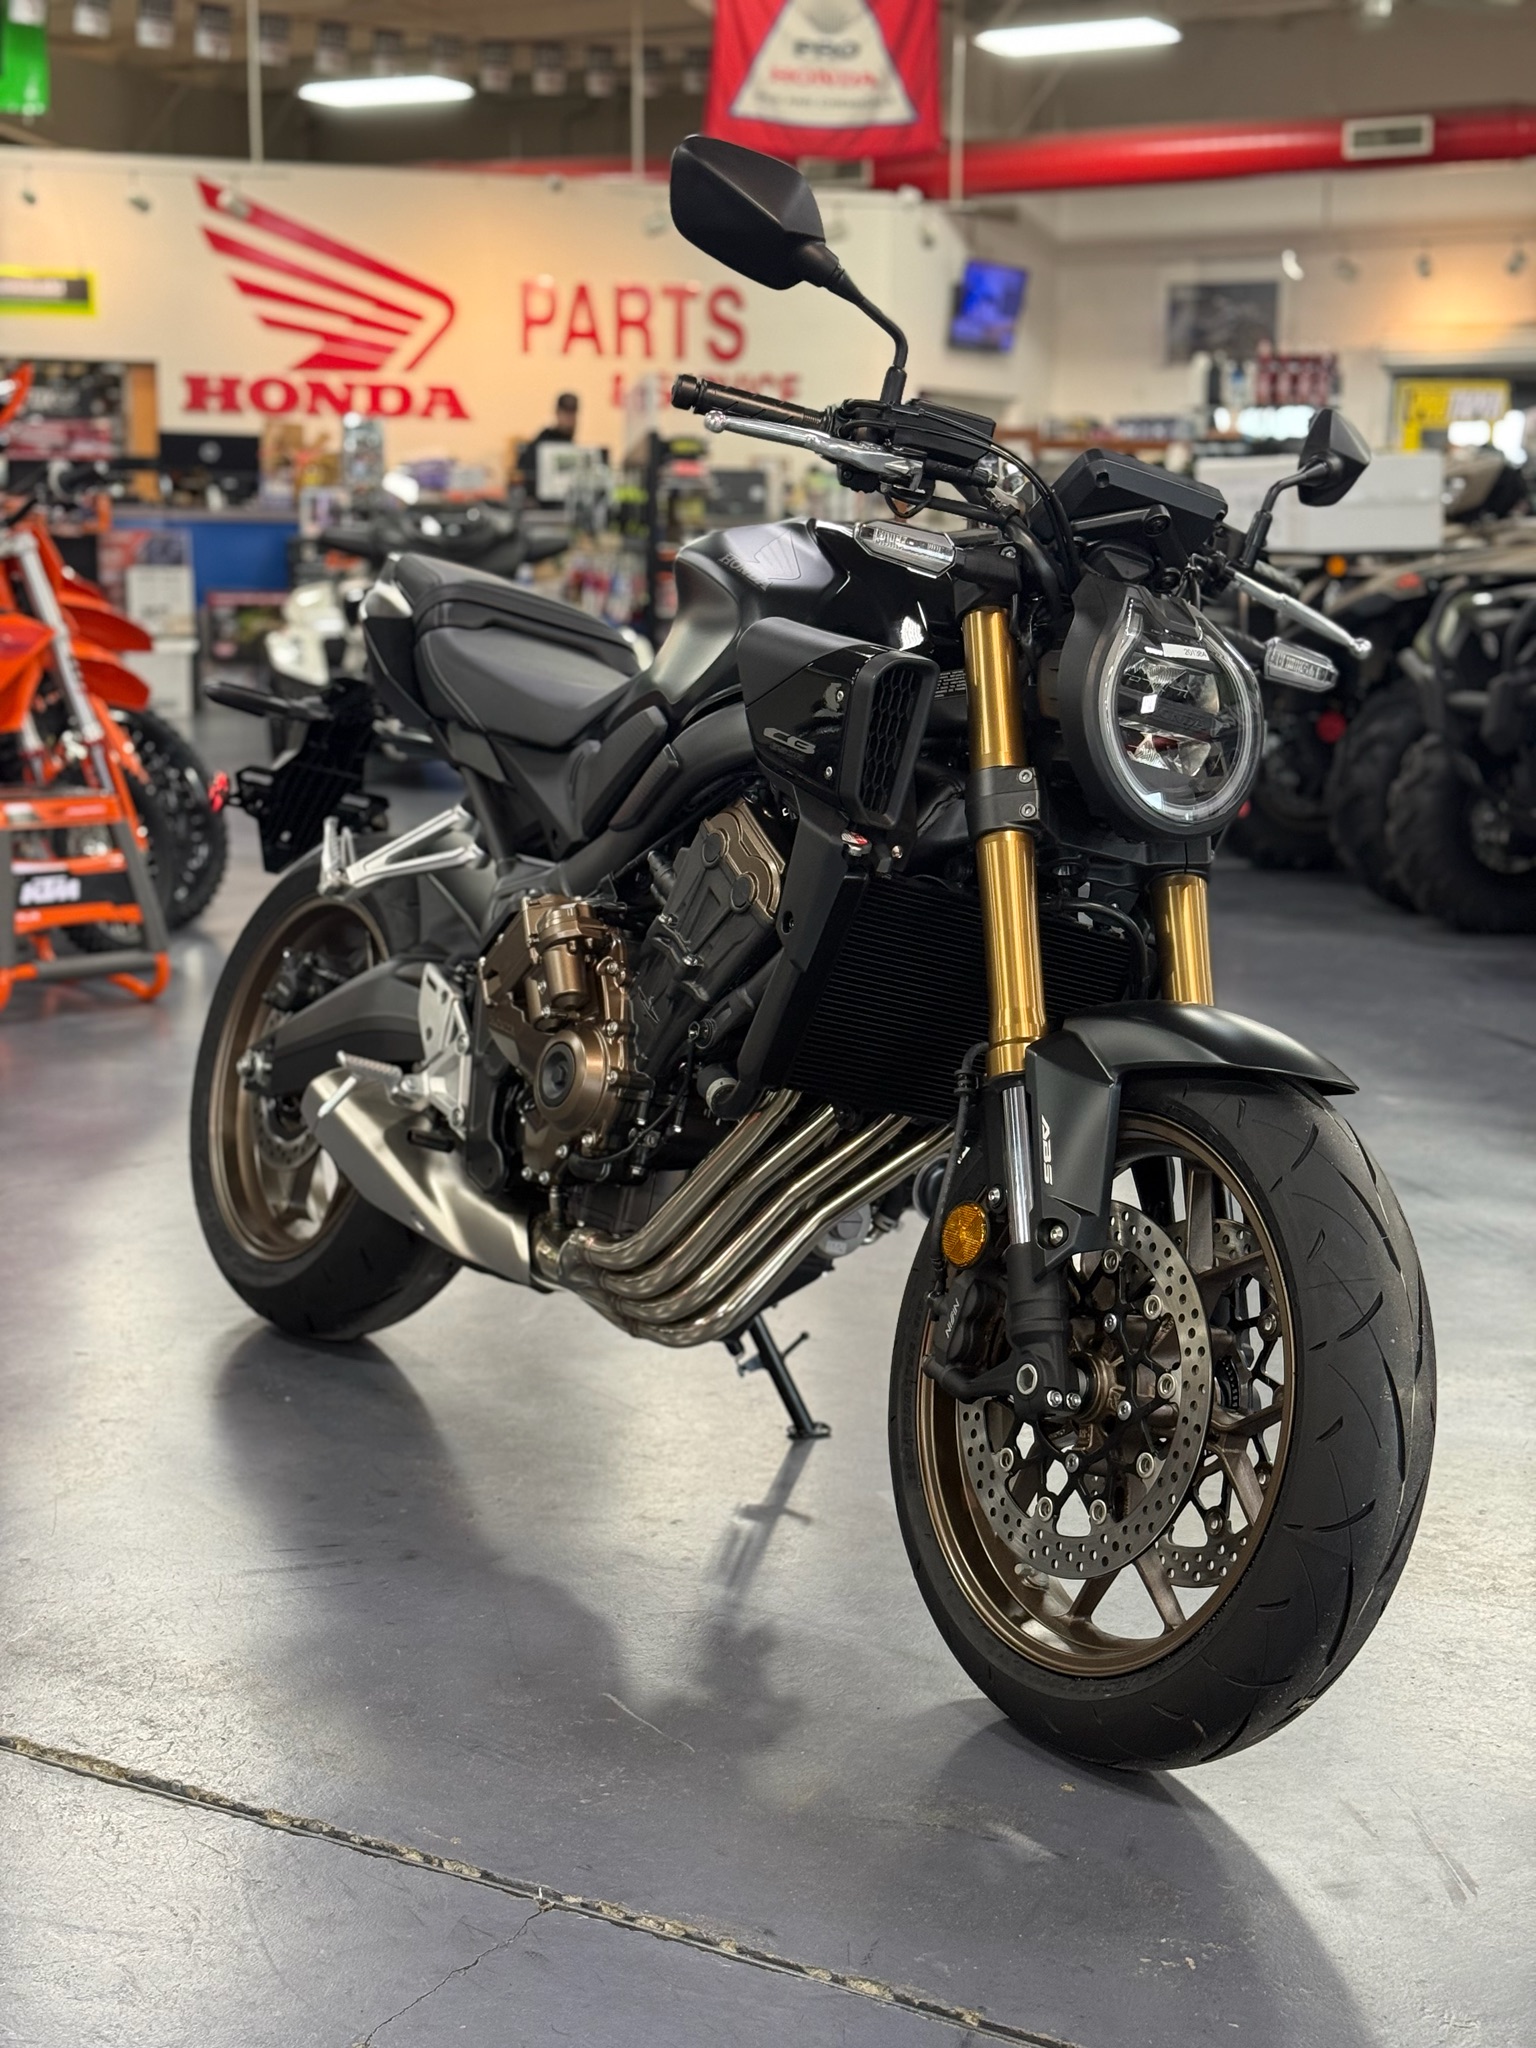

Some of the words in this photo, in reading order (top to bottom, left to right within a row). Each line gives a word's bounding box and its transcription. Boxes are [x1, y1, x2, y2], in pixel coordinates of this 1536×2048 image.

[520, 281, 745, 362] PARTS
[182, 374, 470, 420] HONDA
[763, 727, 816, 755] CB
[1041, 1114, 1053, 1186] ABS
